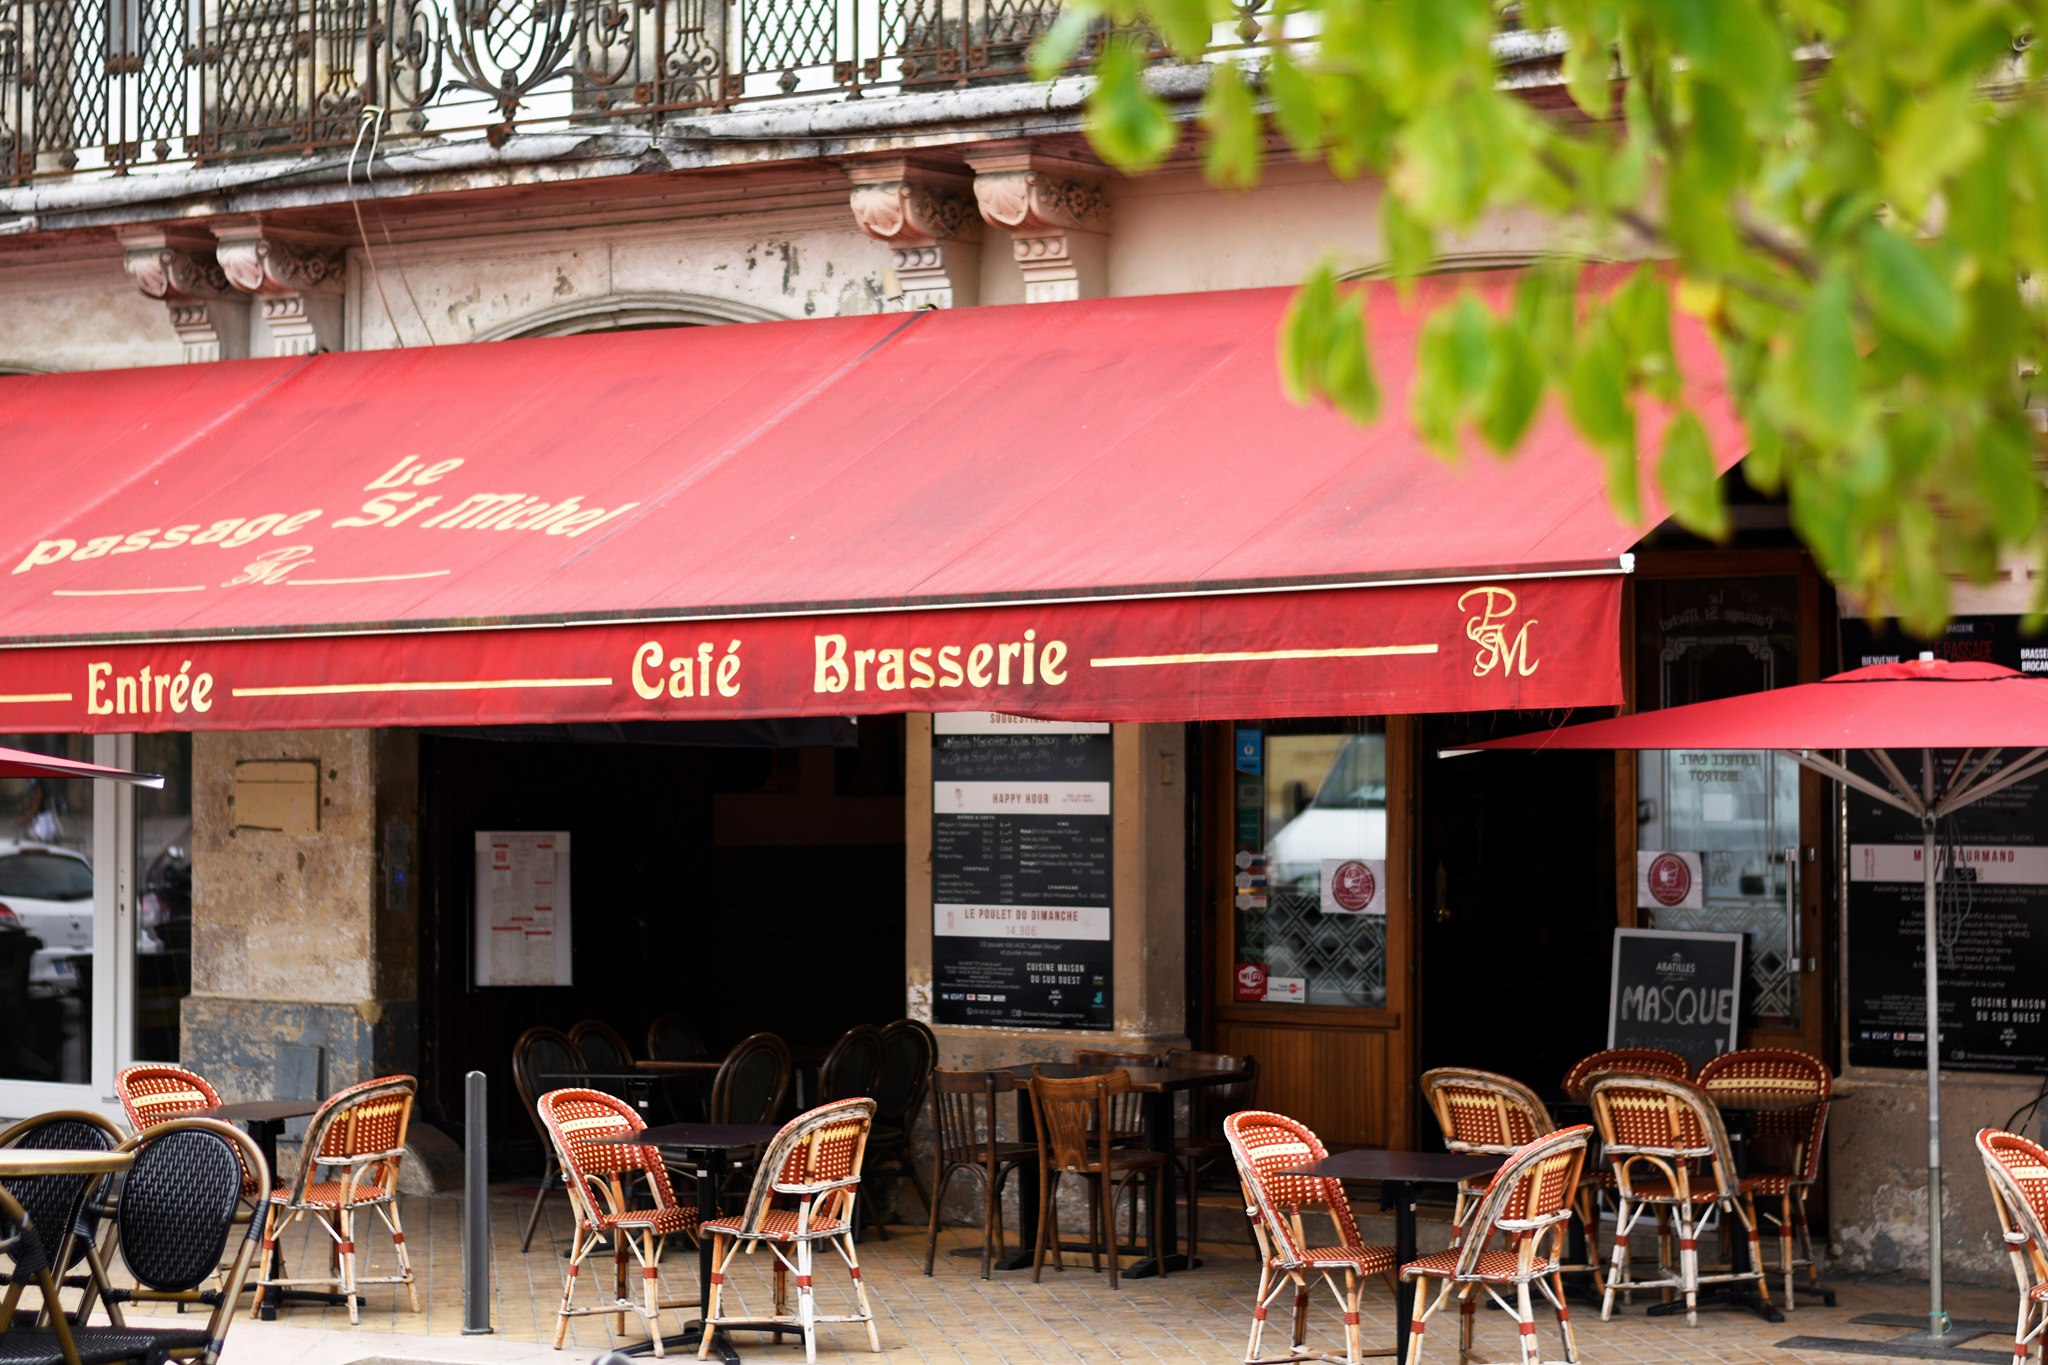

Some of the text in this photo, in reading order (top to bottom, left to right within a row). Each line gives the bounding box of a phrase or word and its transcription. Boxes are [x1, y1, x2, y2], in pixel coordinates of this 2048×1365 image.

[364, 455, 464, 491] Le
[11, 492, 640, 574] passage St Michel
[87, 630, 1069, 714] Entrée Café Brasserie
[992, 793, 1021, 804] HAPPY
[1025, 793, 1049, 804] HOUR
[965, 908, 1079, 922] LE POULET DU DIMANCHE
[1026, 962, 1084, 973] CUISINE MAISON
[1030, 974, 1081, 985] DU SUD OUEST
[1621, 984, 1733, 1025] MASQUE
[1971, 996, 2046, 1010] CUISINE MAISON
[1976, 1010, 2041, 1024] DU SUD OUEST
